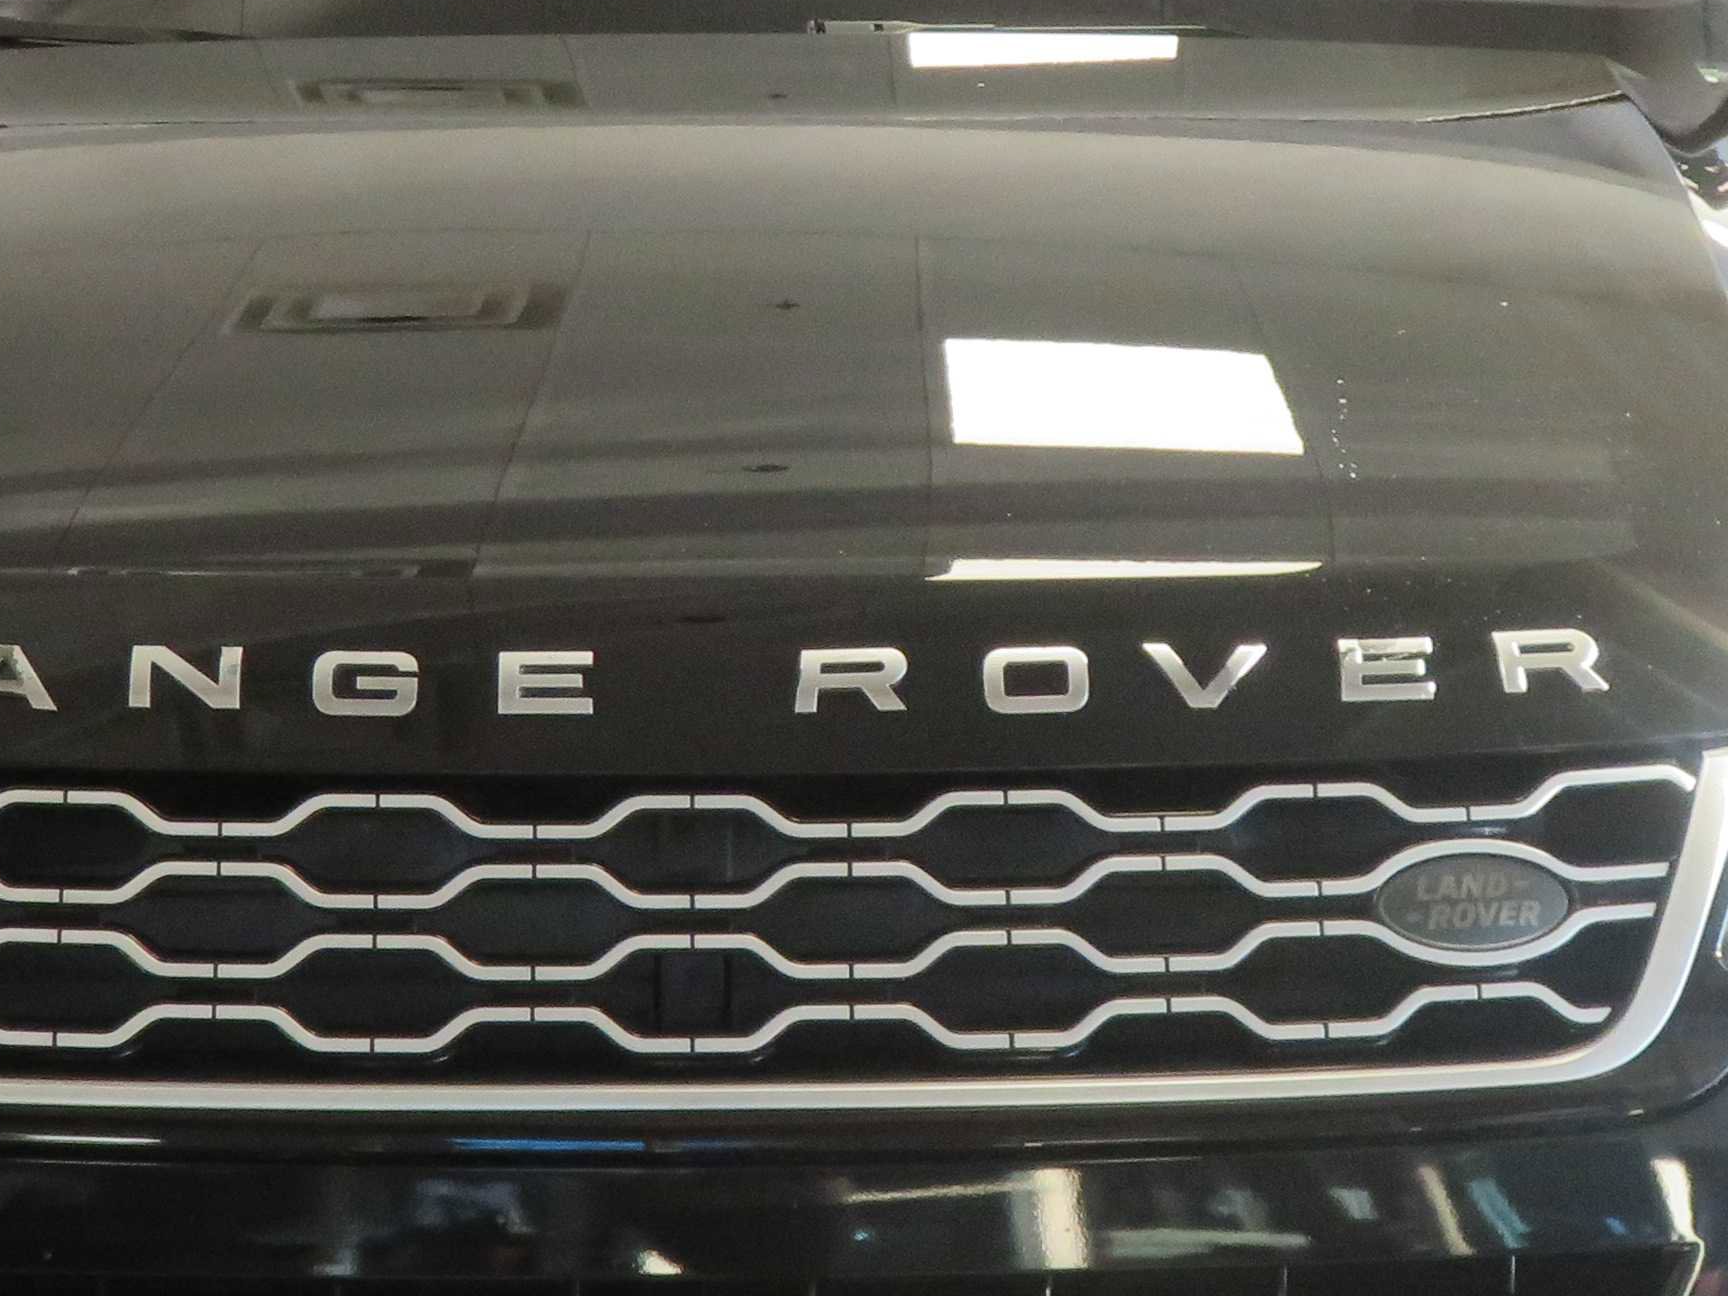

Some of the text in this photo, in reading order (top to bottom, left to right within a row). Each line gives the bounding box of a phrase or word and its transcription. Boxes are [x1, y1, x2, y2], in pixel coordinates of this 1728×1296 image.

[794, 628, 1610, 714] ROVER
[1417, 873, 1507, 900] LAND
[1428, 900, 1541, 930] ROVER
